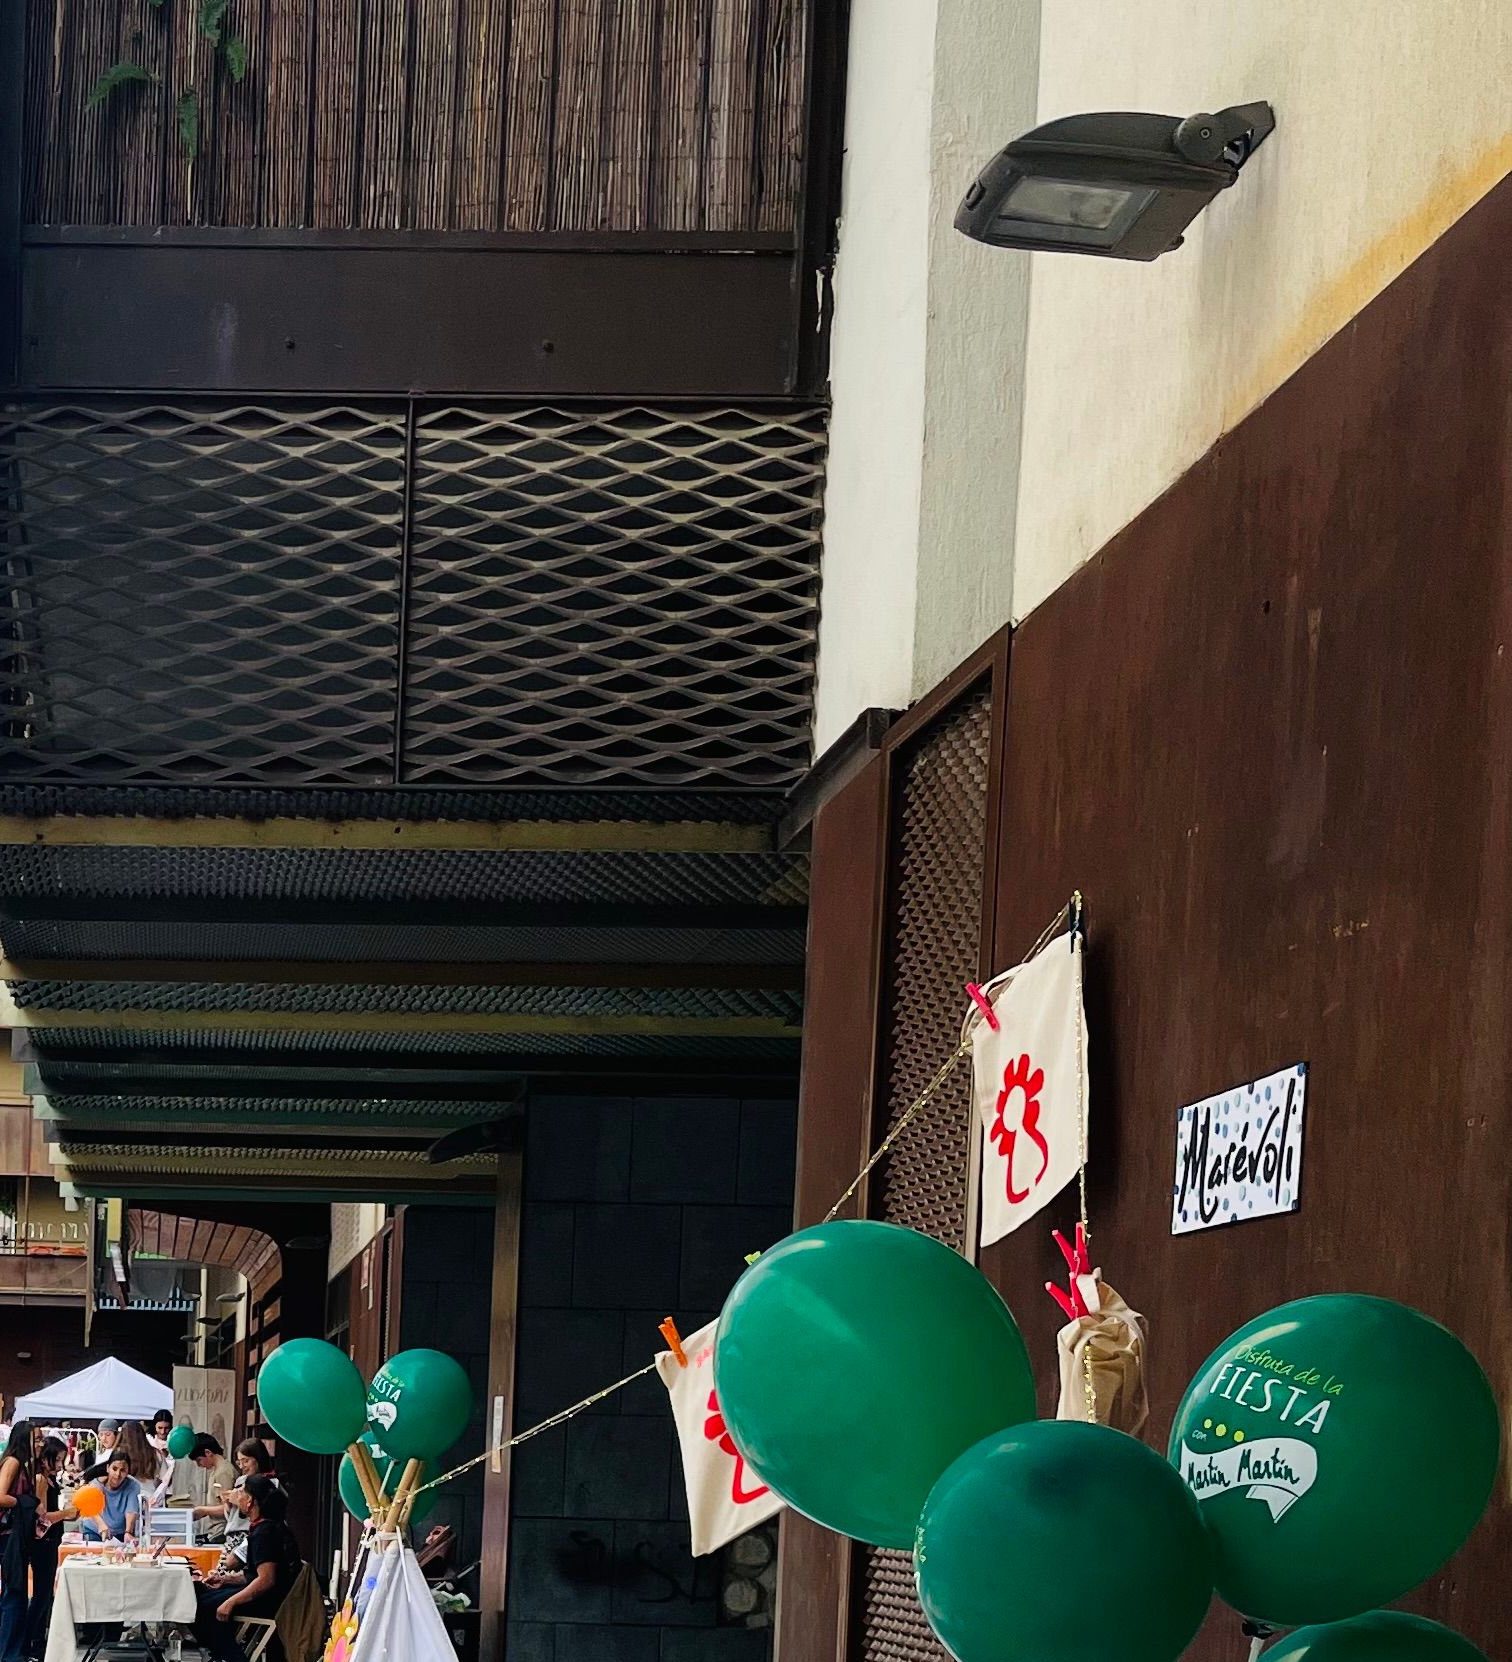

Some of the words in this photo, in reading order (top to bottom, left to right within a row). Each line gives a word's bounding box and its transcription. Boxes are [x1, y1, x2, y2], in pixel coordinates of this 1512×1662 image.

[1209, 1362, 1331, 1434] FIESTA
[1235, 1344, 1295, 1375] Disfruta
[1294, 1367, 1321, 1386] de
[1322, 1375, 1345, 1396] la
